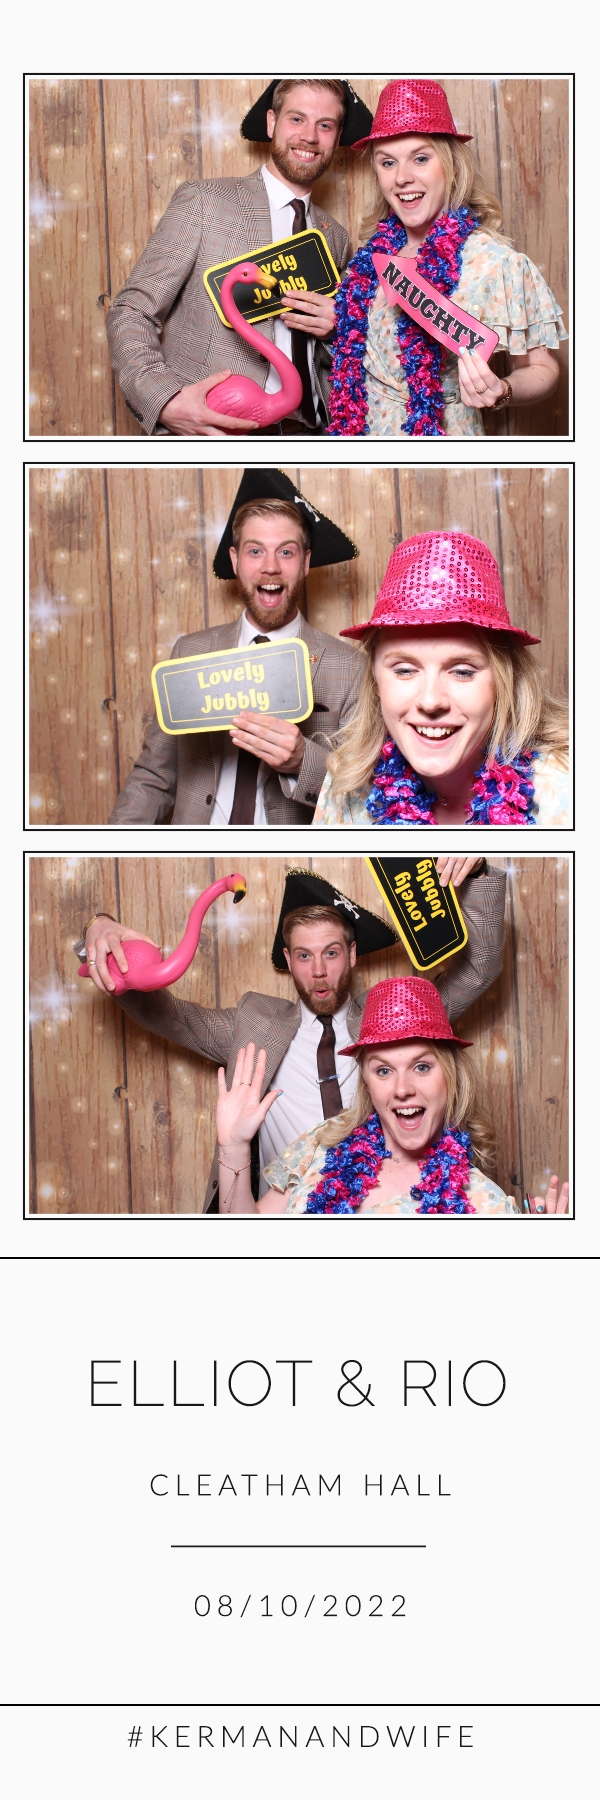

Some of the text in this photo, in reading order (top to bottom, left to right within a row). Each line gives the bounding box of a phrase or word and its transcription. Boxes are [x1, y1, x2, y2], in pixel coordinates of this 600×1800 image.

[259, 253, 298, 275] vely
[253, 275, 308, 305] Jubly
[381, 260, 486, 351] NAUGHTY
[197, 661, 265, 690] Lovely
[201, 688, 270, 714] Jubbly
[394, 871, 428, 932] Lovely
[415, 859, 446, 919] Jubbly
